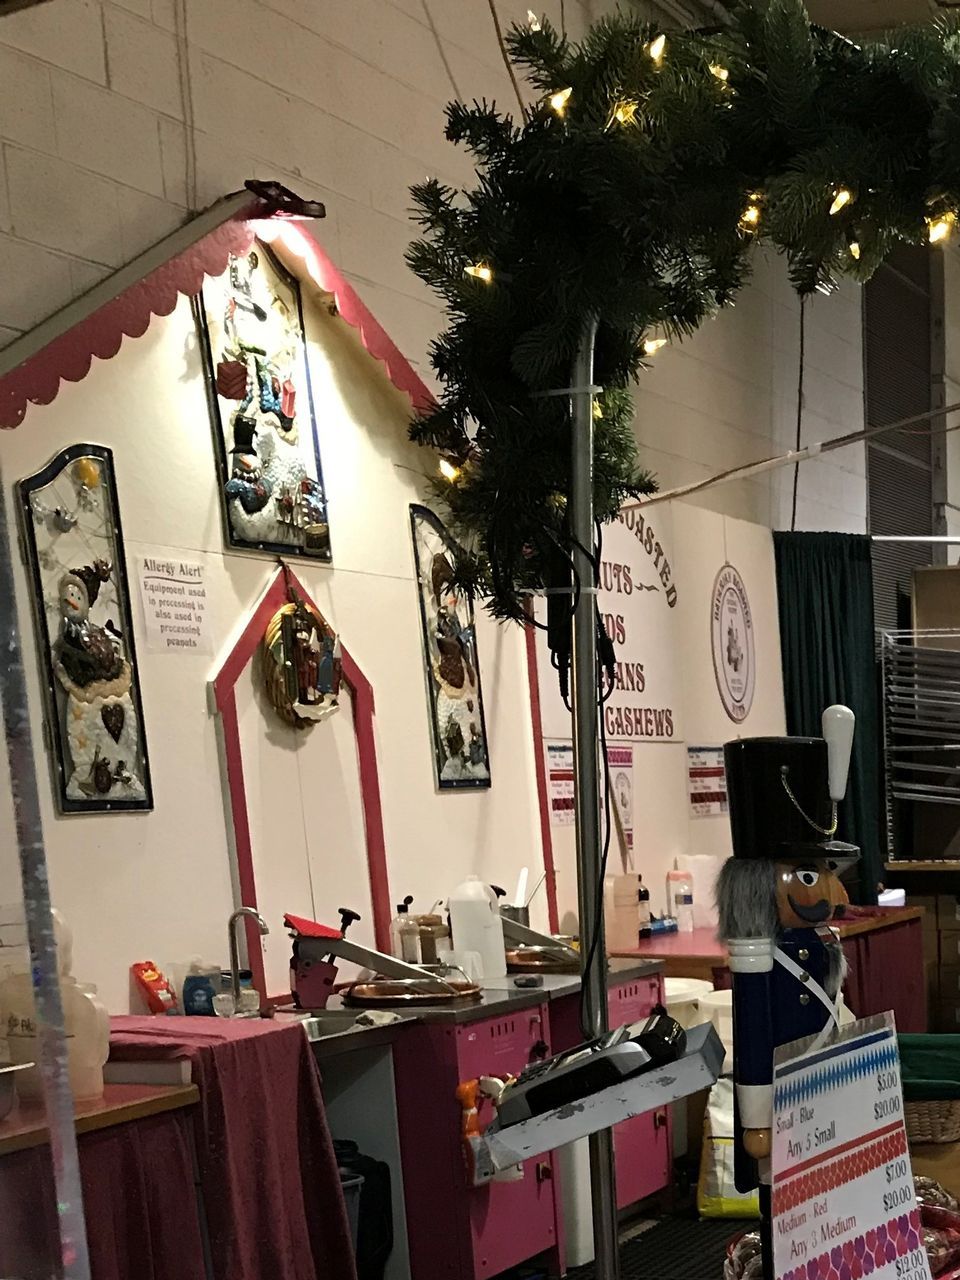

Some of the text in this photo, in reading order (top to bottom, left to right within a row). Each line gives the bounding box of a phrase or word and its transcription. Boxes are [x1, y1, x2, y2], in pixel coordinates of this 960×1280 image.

[143, 559, 176, 576] Allergy
[143, 581, 206, 598] Equipment used
[148, 596, 205, 611] in processing is
[155, 609, 203, 624] also used in
[160, 624, 202, 637] processing
[166, 638, 198, 648] peanuts
[605, 706, 674, 738] CASHEWS
[776, 1112, 795, 1134] Small
[800, 1106, 815, 1124] Blue
[877, 1071, 898, 1092] $5.00
[787, 1095, 900, 1161] Any 5 Small $20.00
[777, 1211, 808, 1236] Medium
[813, 1199, 829, 1218] Red
[885, 1160, 907, 1184] $7.00
[790, 1185, 912, 1261] Any 3 Medium $20.00
[895, 1250, 924, 1277] $12.00
